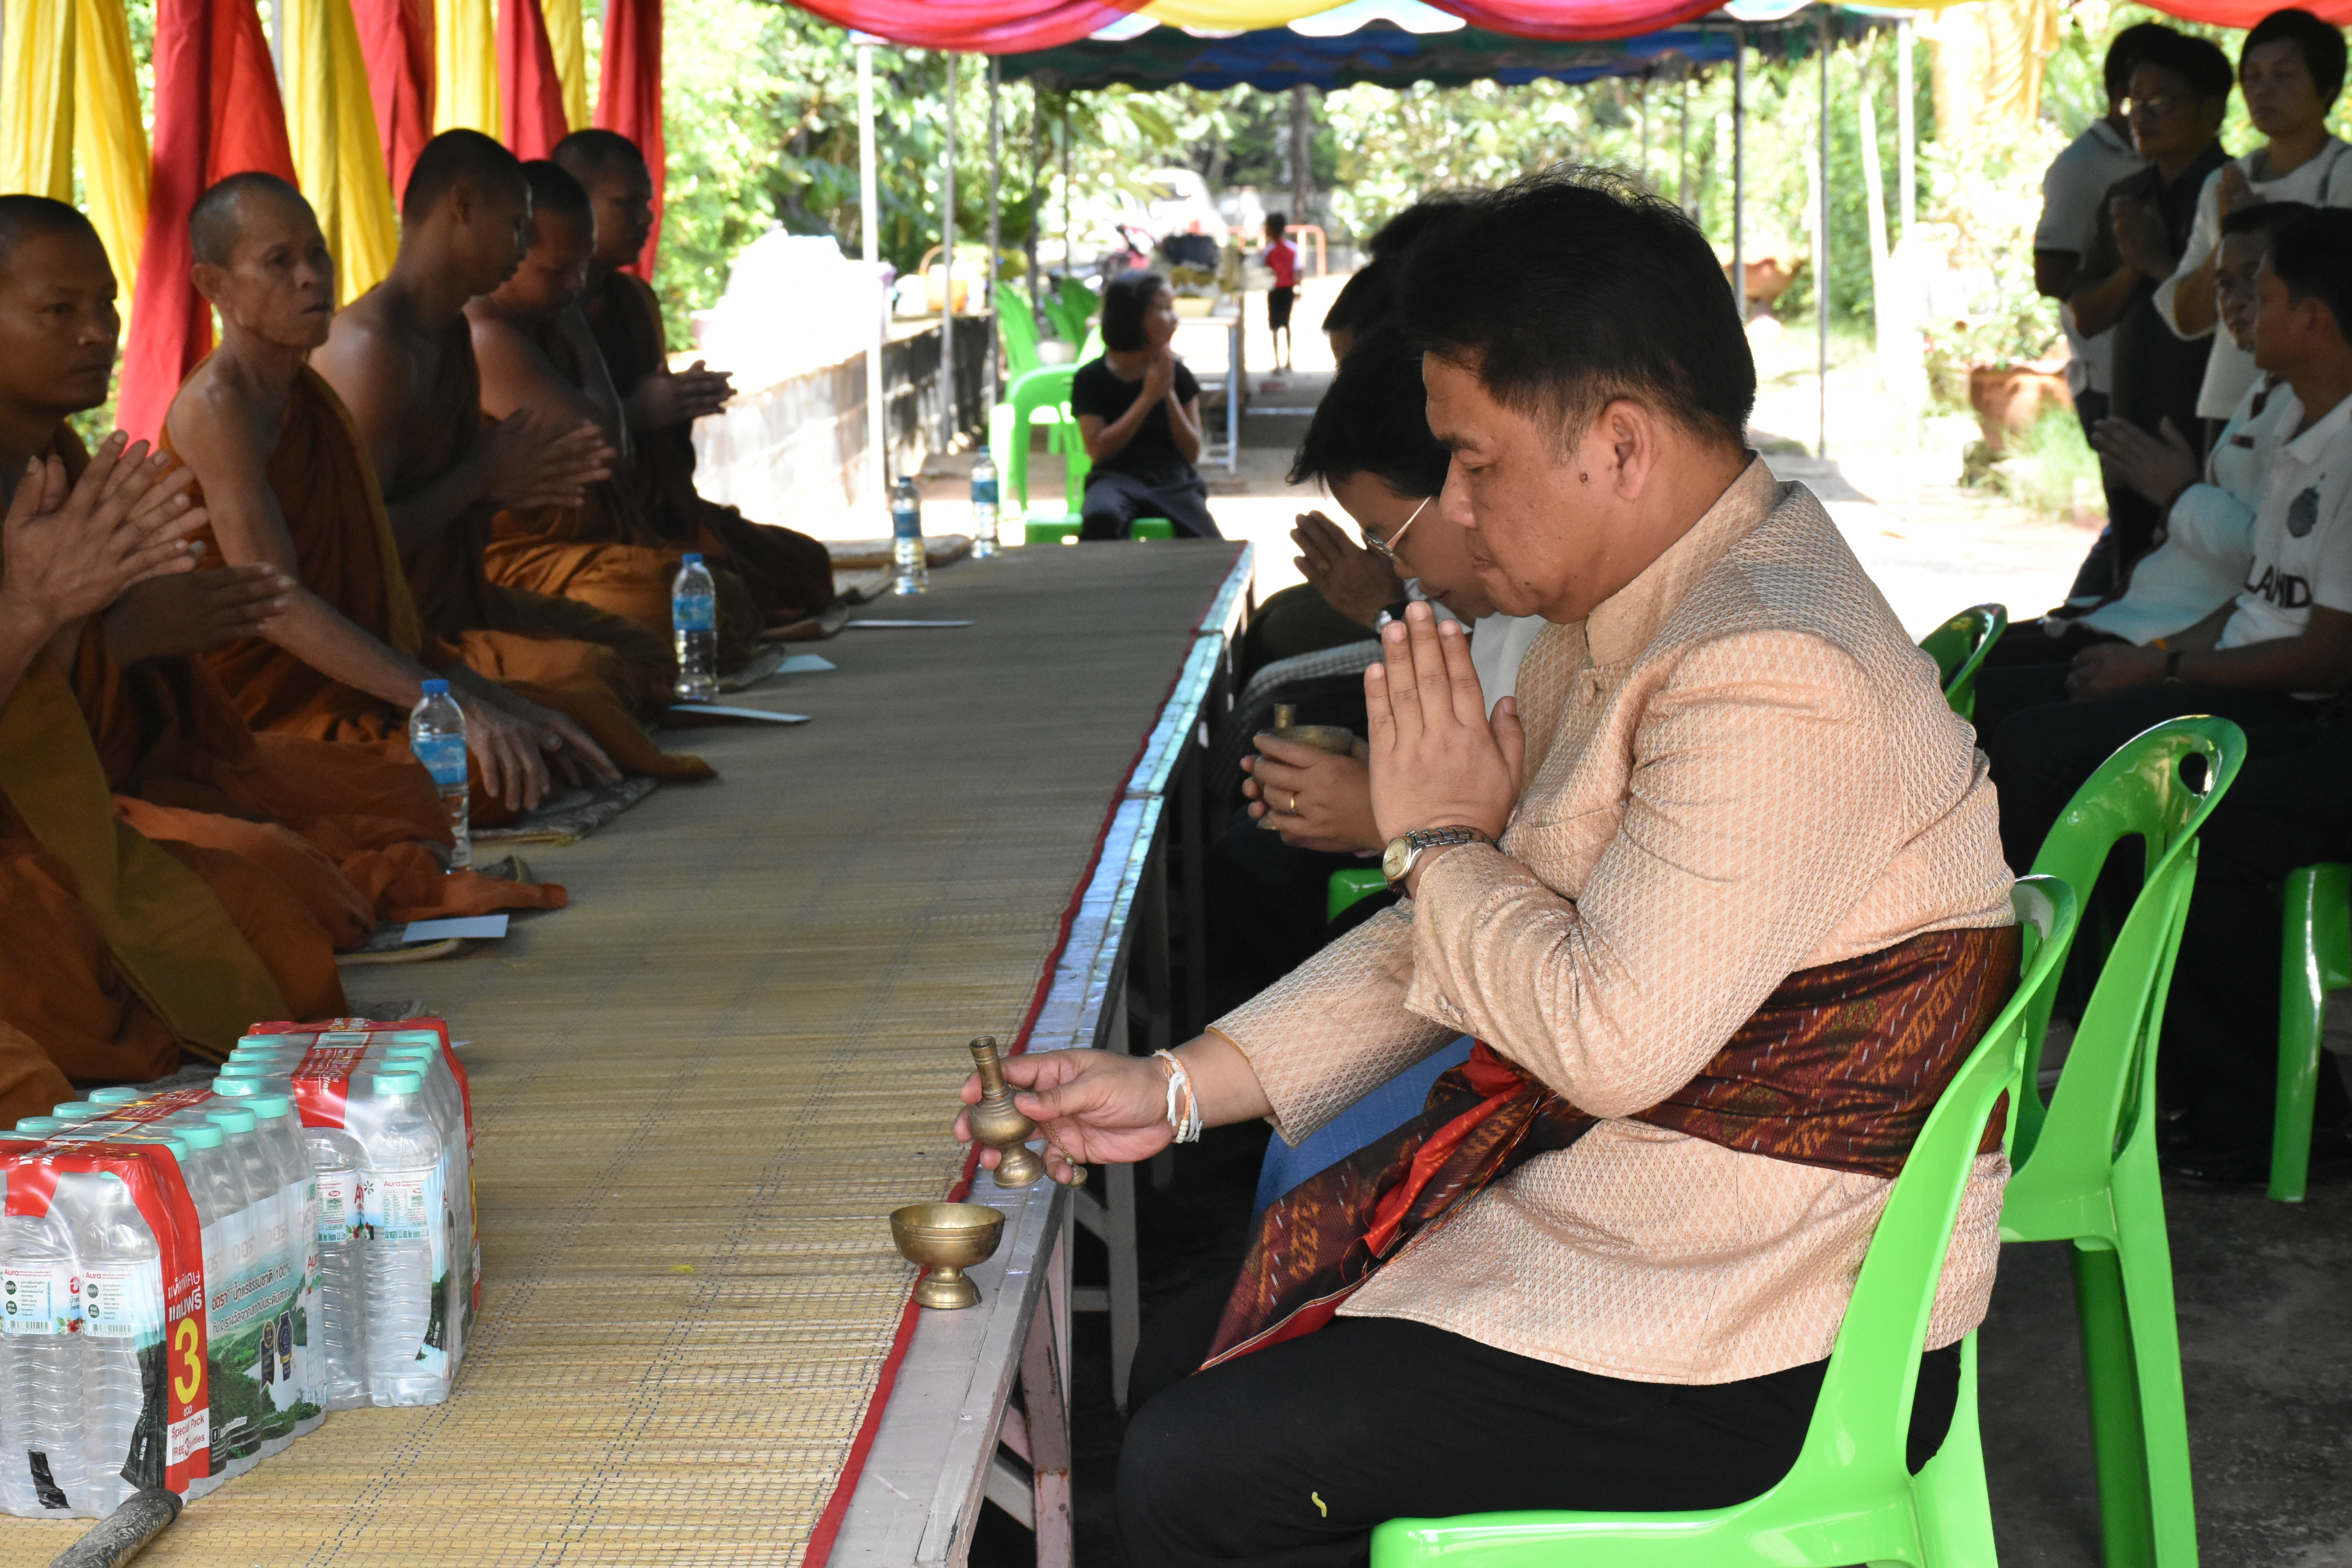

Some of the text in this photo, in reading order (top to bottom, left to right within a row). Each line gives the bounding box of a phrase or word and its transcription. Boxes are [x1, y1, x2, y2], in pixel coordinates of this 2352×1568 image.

[2243, 555, 2312, 608] LAND
[174, 1318, 201, 1404] 3
[172, 1414, 205, 1440] Special Pack
[172, 1434, 205, 1457] FREE 3 bottles
